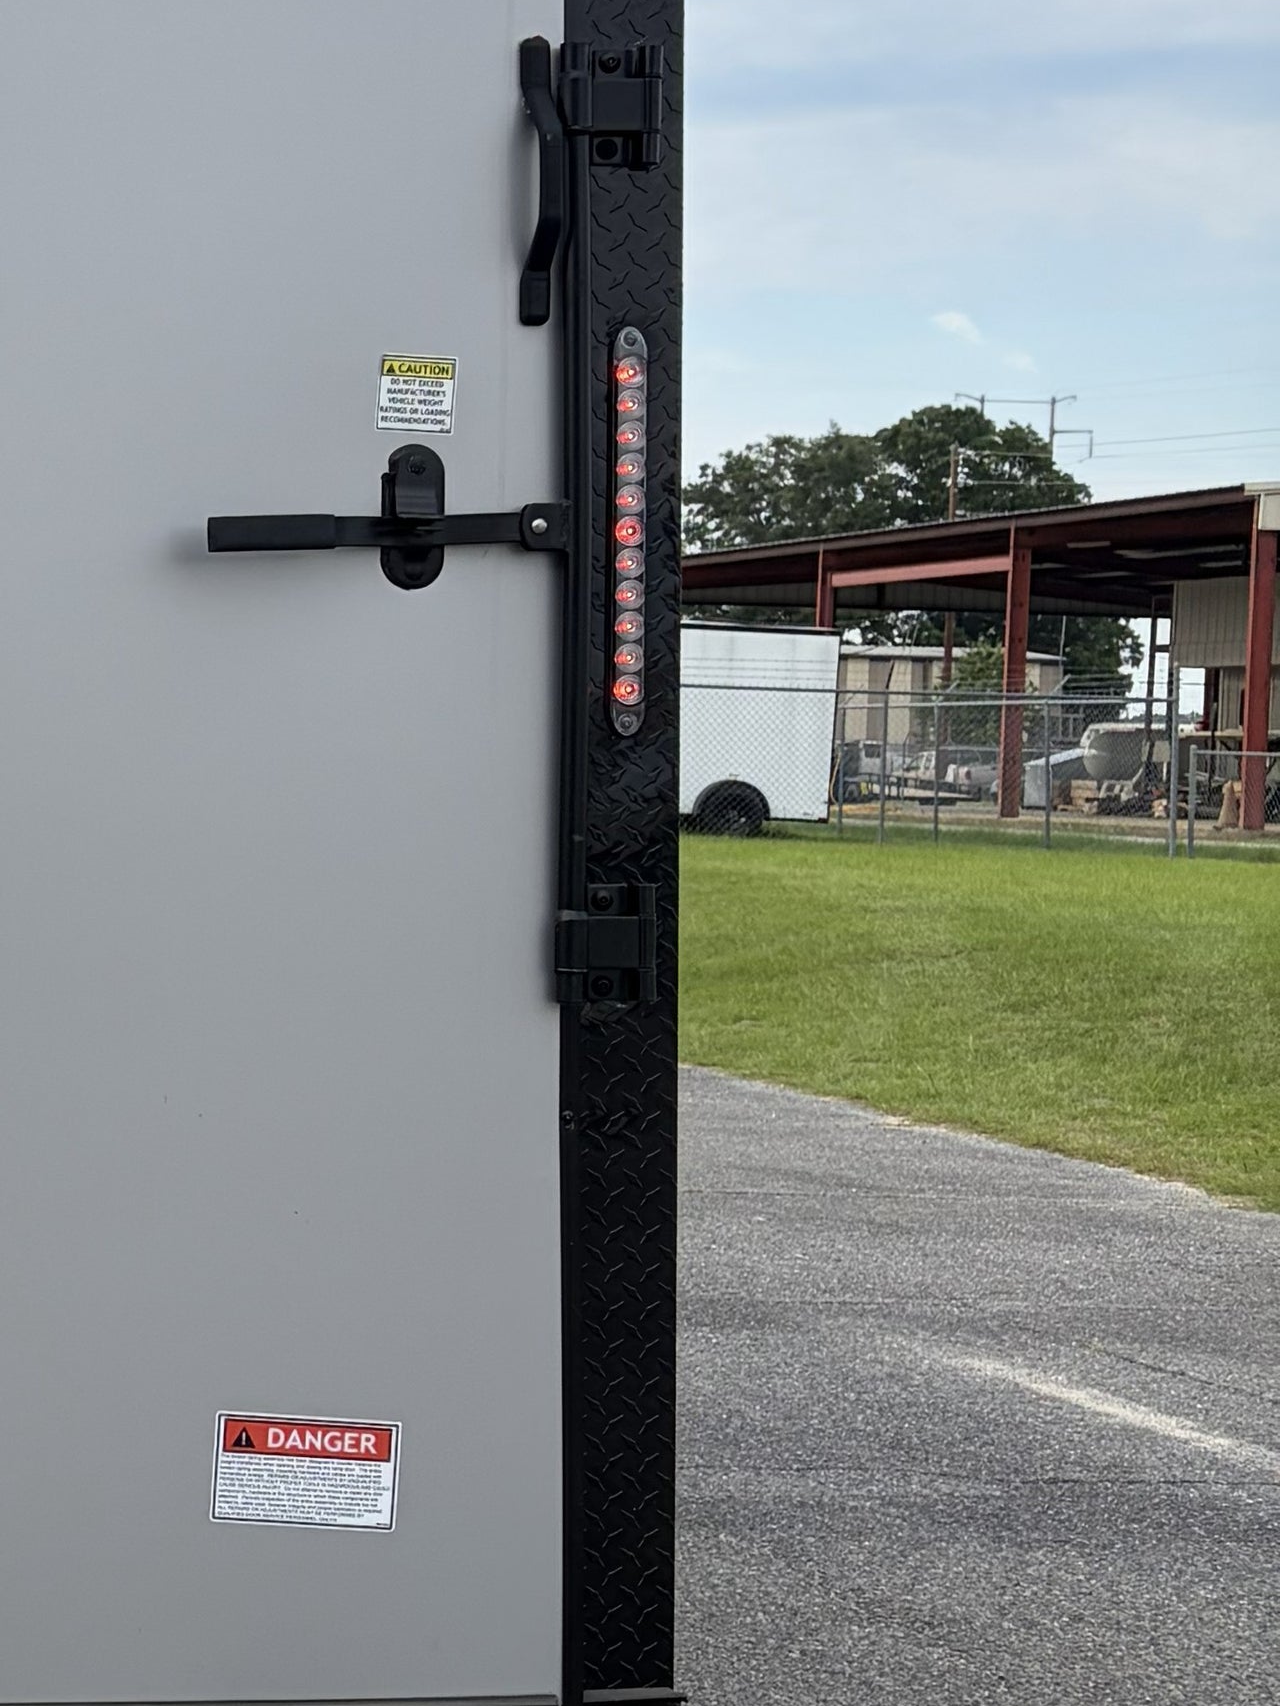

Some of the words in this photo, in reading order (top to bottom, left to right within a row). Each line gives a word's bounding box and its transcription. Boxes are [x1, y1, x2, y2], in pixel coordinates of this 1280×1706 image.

[398, 363, 449, 376] CAUTION
[418, 380, 444, 388] EXCEED
[388, 397, 415, 405] VEHICLE
[417, 398, 444, 406] WEIGHT
[380, 406, 407, 414] RATINGS
[409, 407, 419, 415] OR
[420, 408, 450, 417] LOADING
[267, 1427, 378, 1455] DANGER
